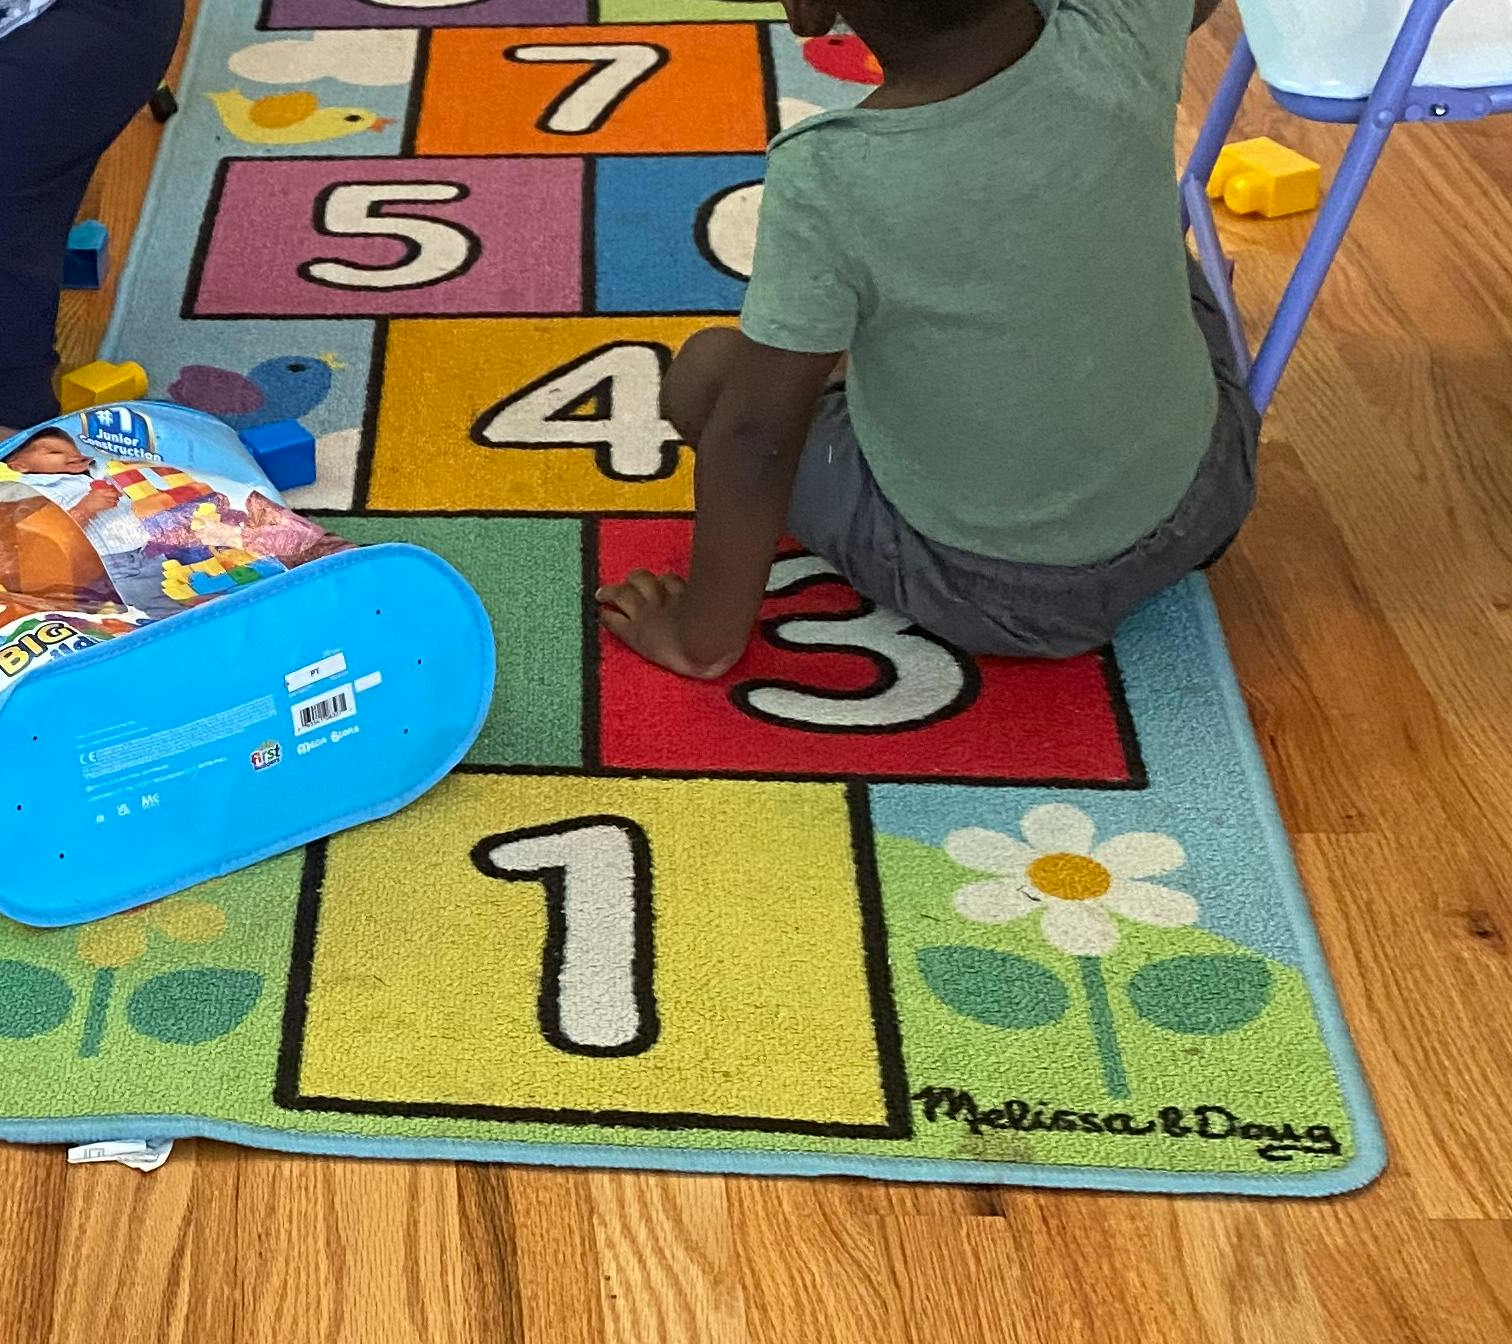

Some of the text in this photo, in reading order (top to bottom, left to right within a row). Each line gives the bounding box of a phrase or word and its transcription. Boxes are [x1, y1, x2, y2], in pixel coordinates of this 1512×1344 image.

[503, 41, 671, 135] 7
[296, 179, 483, 292] 5
[79, 434, 163, 462] Construction
[95, 407, 132, 434] #1
[96, 428, 140, 448] Junior
[470, 341, 695, 483] 4
[730, 551, 981, 735] 3
[469, 813, 660, 1058] 1
